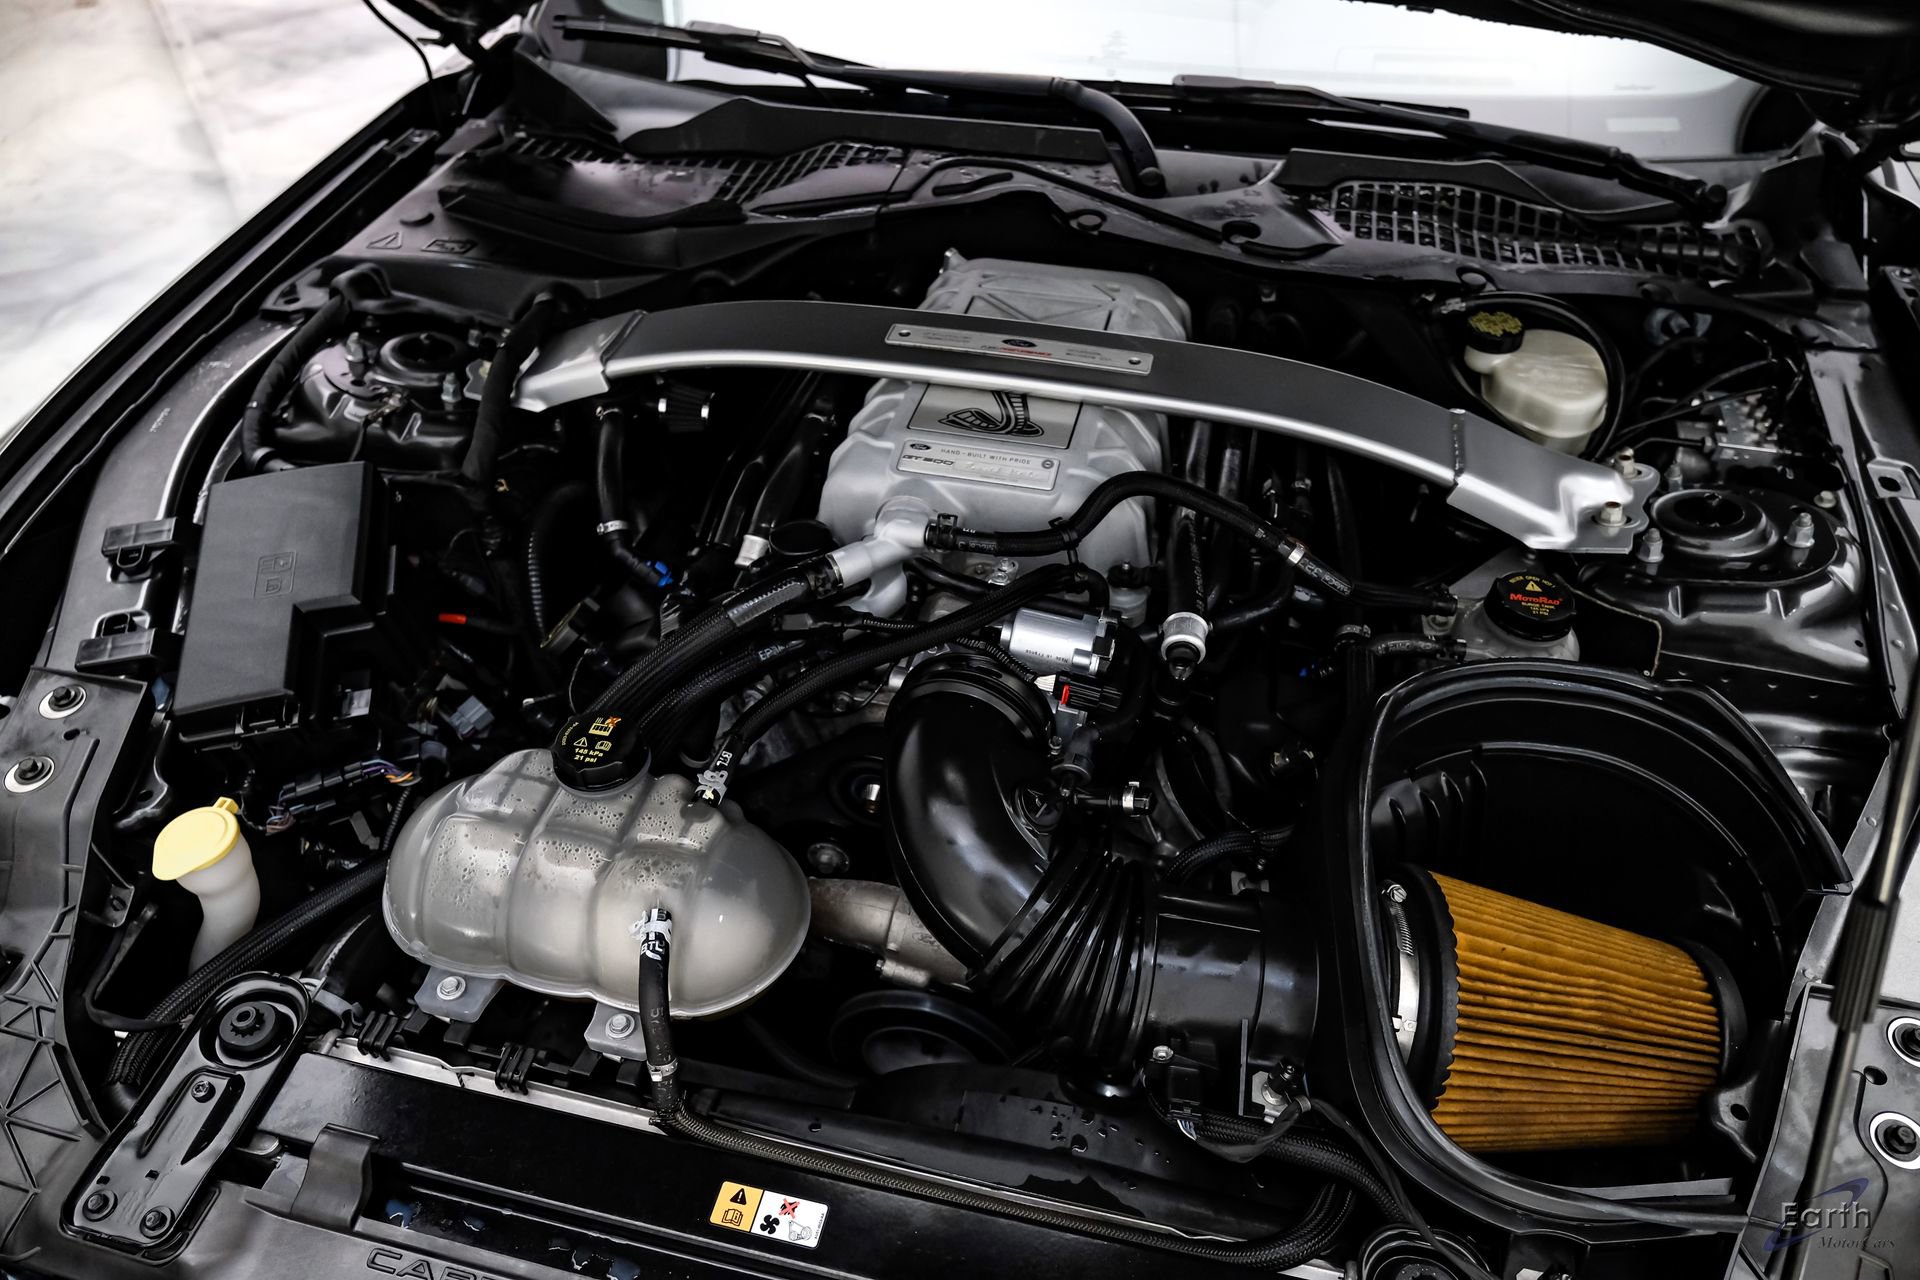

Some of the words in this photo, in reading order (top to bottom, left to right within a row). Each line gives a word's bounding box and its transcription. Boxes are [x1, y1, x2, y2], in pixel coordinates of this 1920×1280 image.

[967, 451, 987, 459] BUILT
[1009, 457, 1032, 465] PRIDE
[574, 747, 589, 755] 145
[588, 749, 604, 758] kPa
[584, 756, 598, 764] psi
